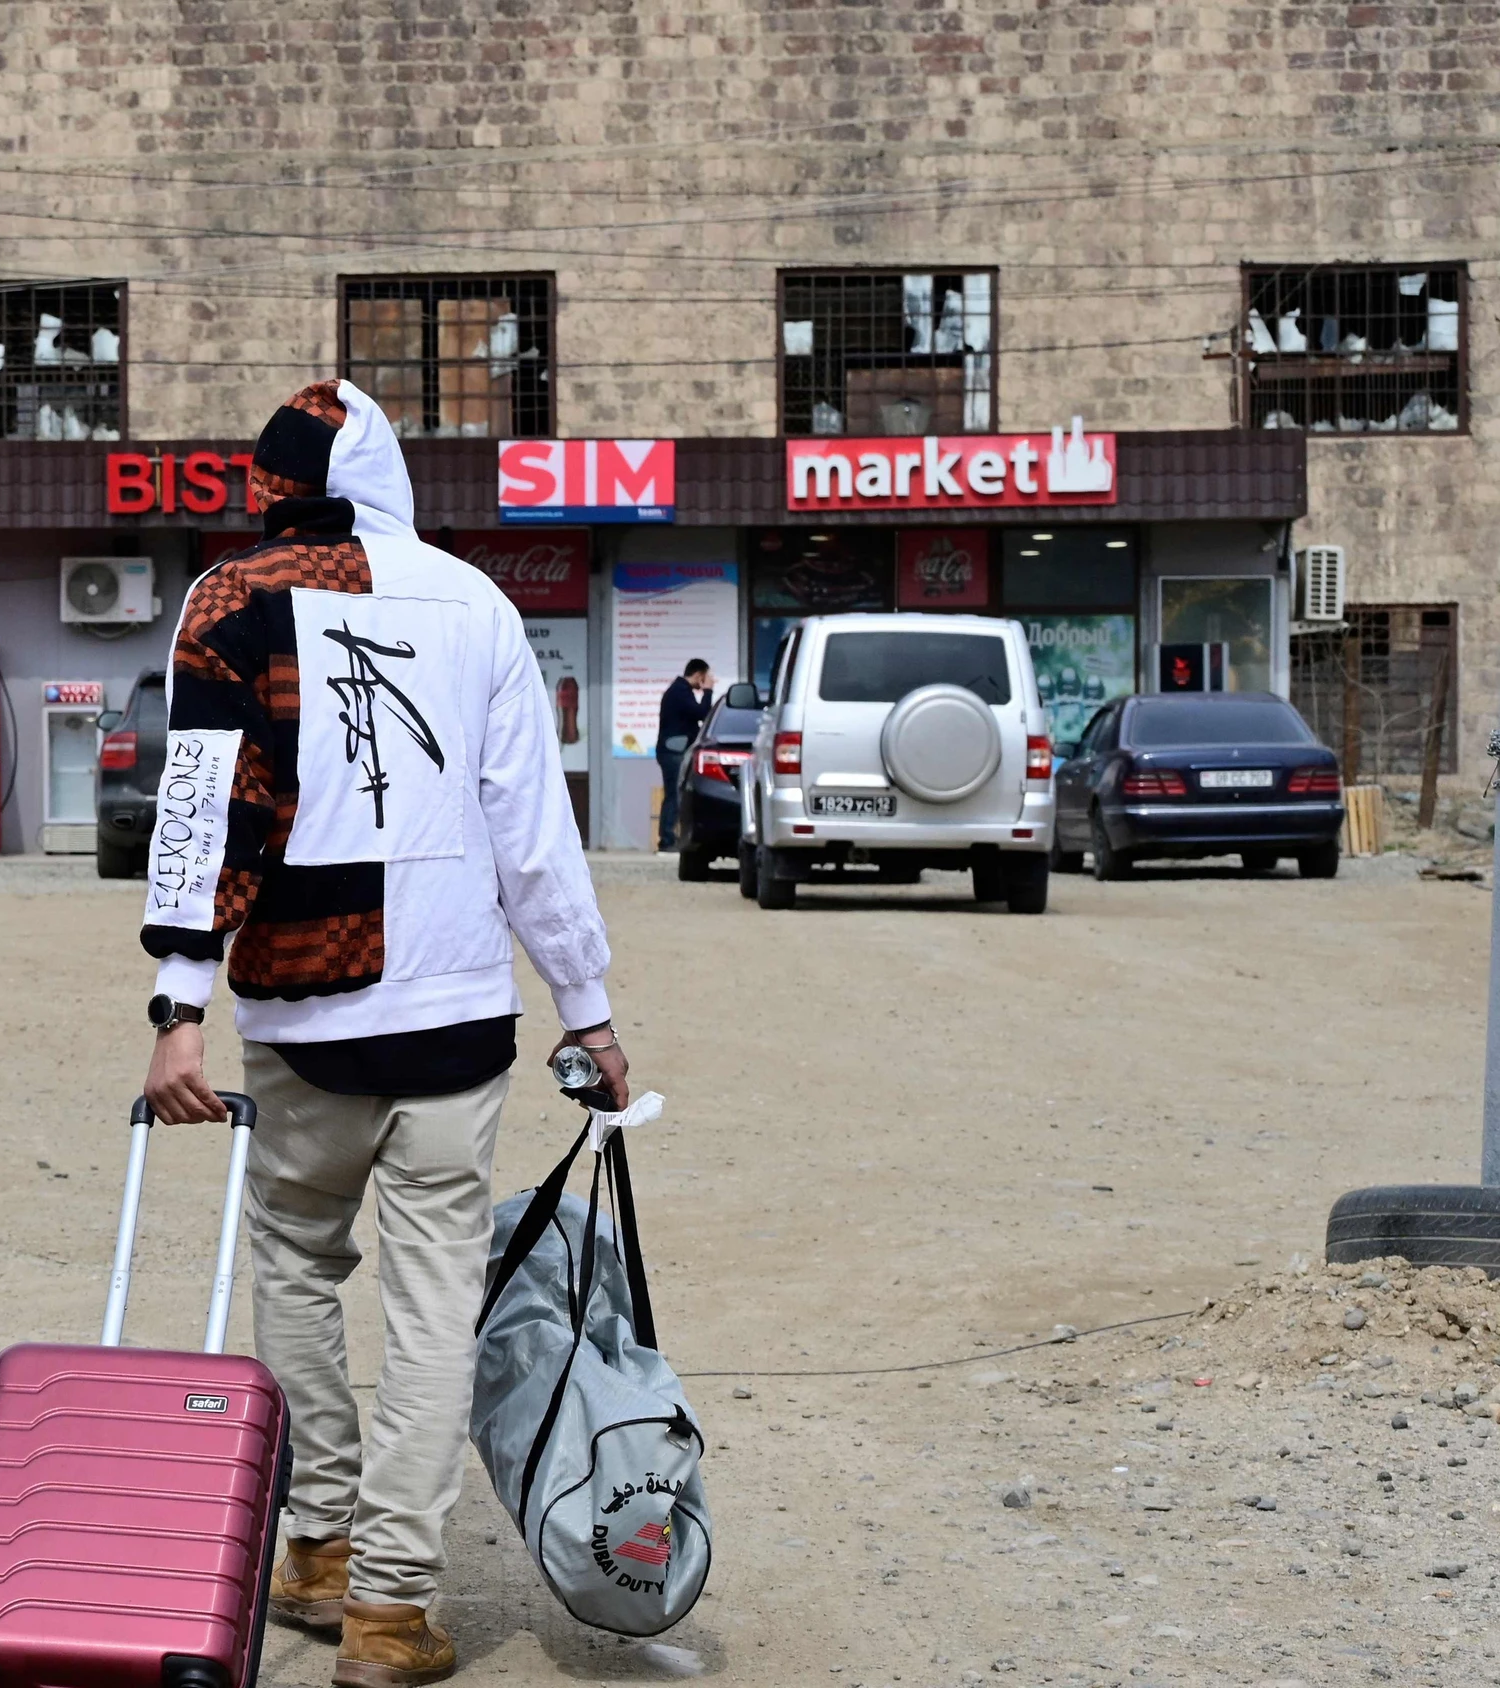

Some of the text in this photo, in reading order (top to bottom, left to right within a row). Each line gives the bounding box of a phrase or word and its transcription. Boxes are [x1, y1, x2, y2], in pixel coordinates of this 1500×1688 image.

[499, 440, 674, 506] SIM
[793, 437, 1038, 498] market
[1028, 622, 1111, 647] Добрый
[189, 874, 205, 895] The
[201, 756, 220, 809] Fashion
[819, 796, 854, 813] 1829
[877, 797, 890, 809] 12
[192, 1399, 222, 1408] safari
[591, 1524, 665, 1595] DUBAI DUTY
